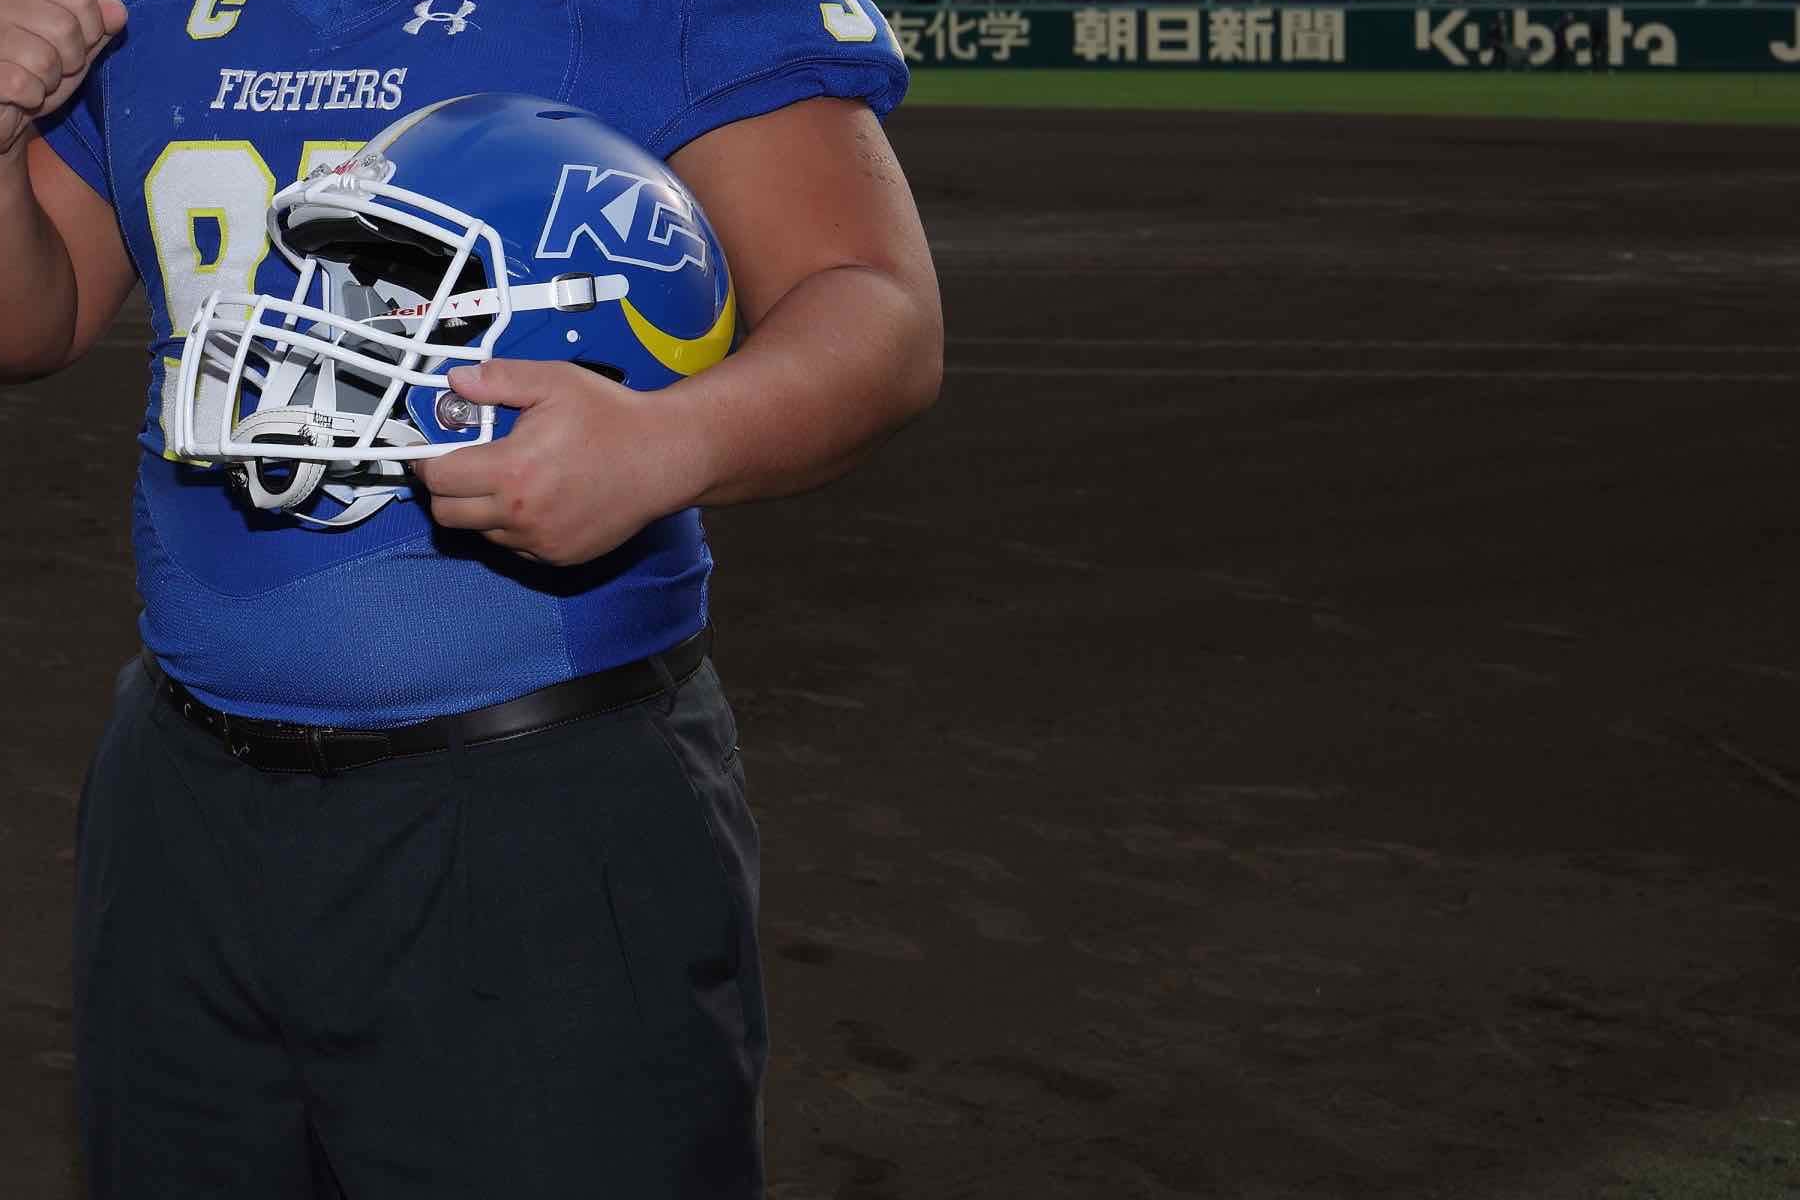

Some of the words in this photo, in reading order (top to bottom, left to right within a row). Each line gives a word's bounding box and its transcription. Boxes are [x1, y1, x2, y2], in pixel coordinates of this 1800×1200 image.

[1072, 7, 1347, 62] 朝日新聞
[210, 67, 408, 112] FIGHTERS
